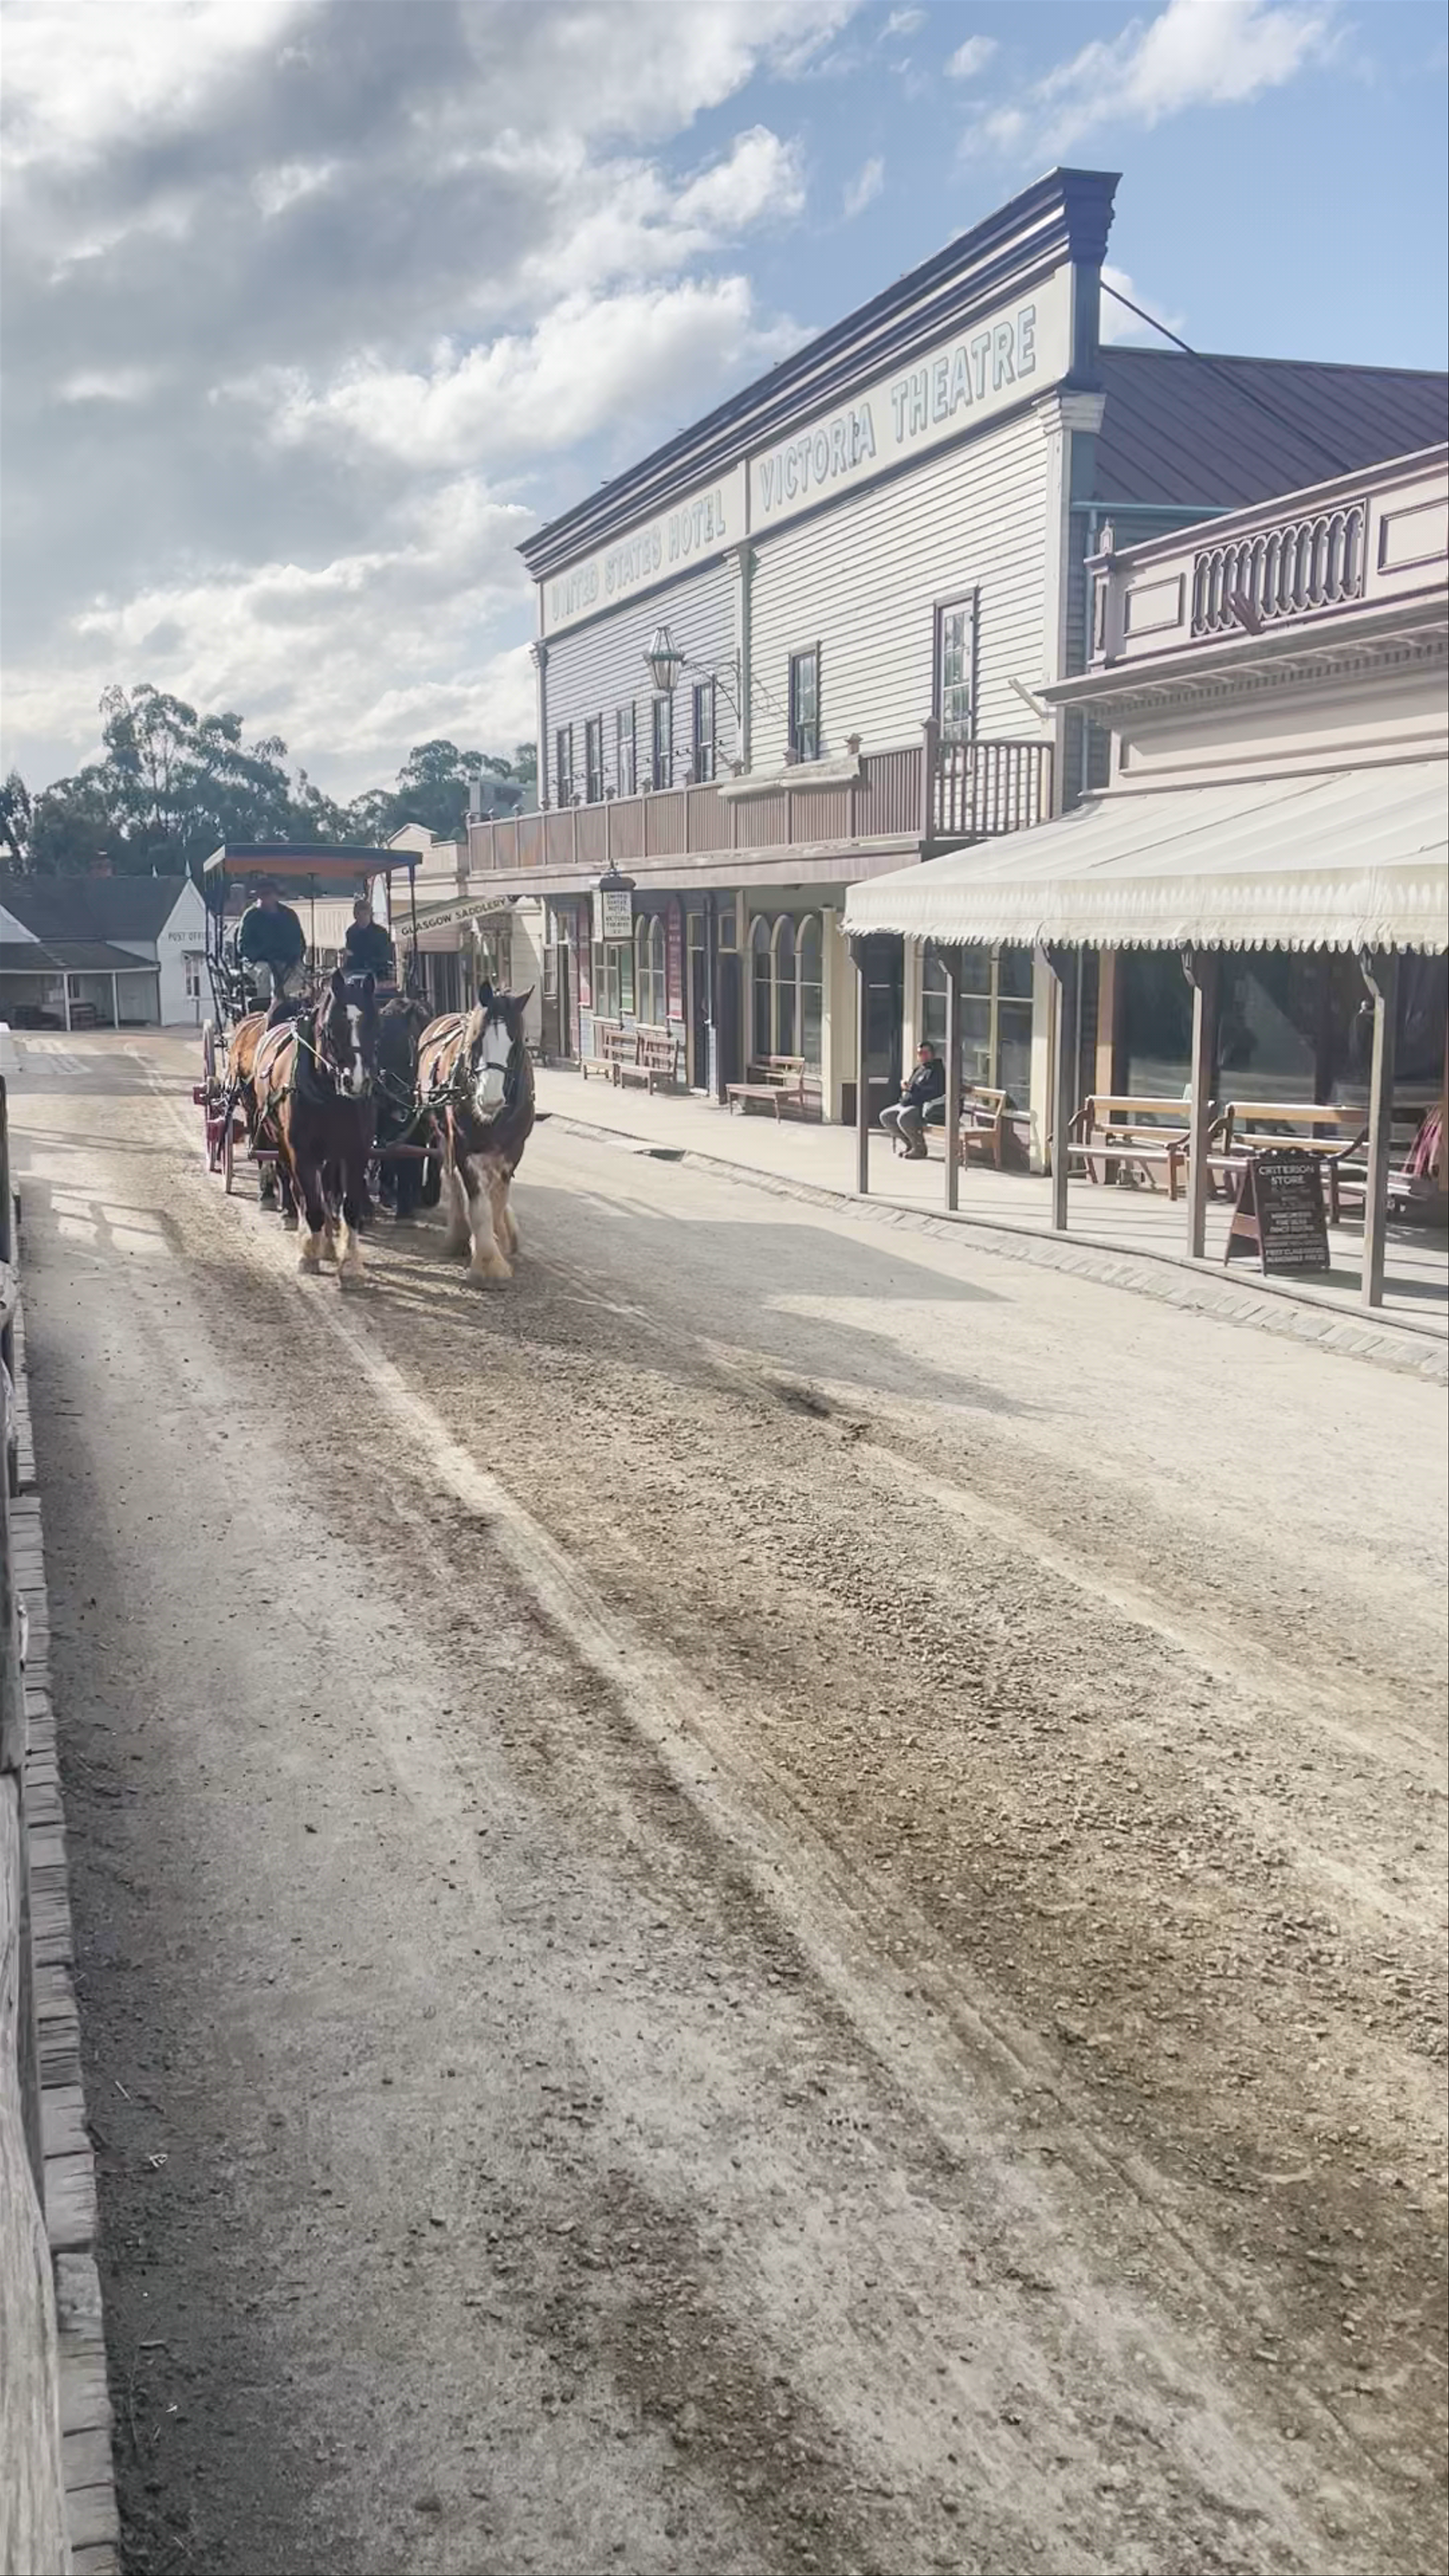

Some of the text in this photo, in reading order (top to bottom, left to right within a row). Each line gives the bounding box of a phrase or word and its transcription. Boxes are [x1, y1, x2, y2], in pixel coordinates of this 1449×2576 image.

[759, 304, 1036, 512] VICTORIA THEATRE
[552, 489, 726, 621] UNITED STATES HOTEL
[401, 898, 506, 936] GLASGOW SADDLERY
[168, 932, 185, 942] POST
[1259, 1165, 1315, 1175] CRITERION
[1271, 1175, 1306, 1186] STORE
